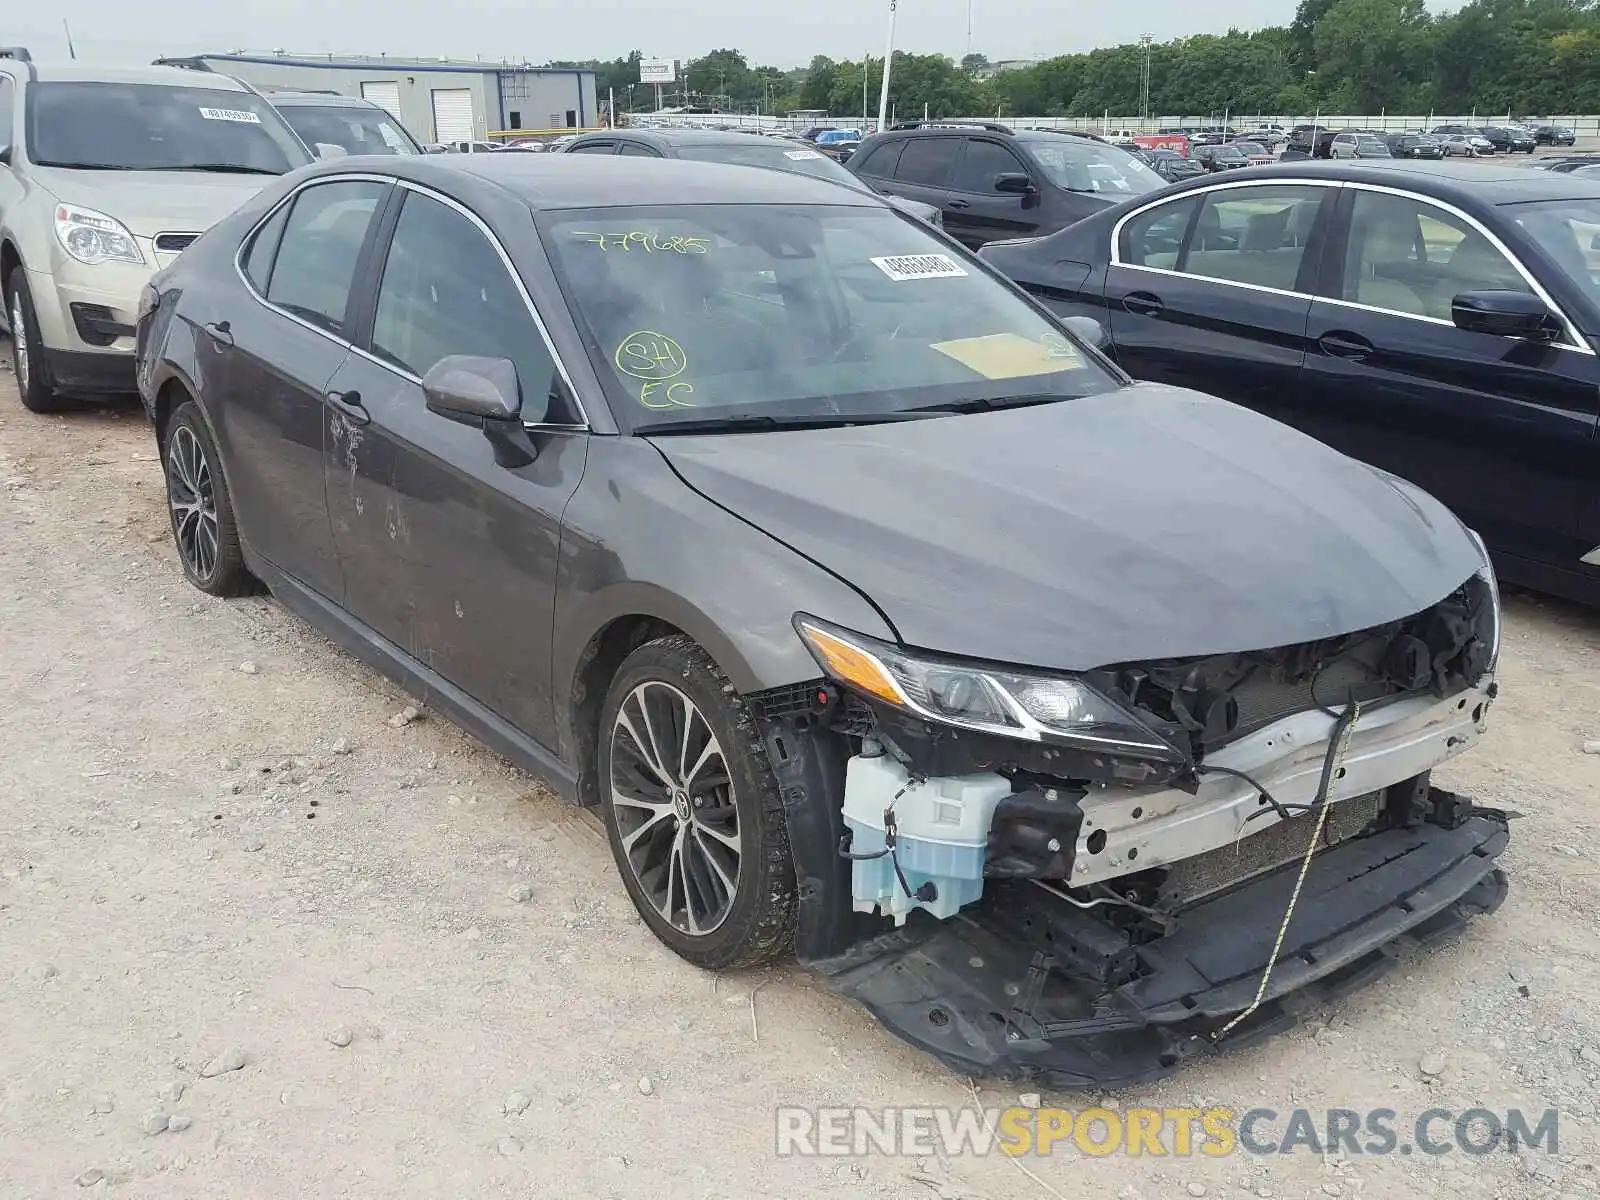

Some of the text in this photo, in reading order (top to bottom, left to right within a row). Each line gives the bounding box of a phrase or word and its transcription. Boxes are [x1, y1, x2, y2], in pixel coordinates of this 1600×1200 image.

[572, 231, 711, 254] 779685
[625, 341, 680, 370] SH
[640, 382, 697, 407] EC
